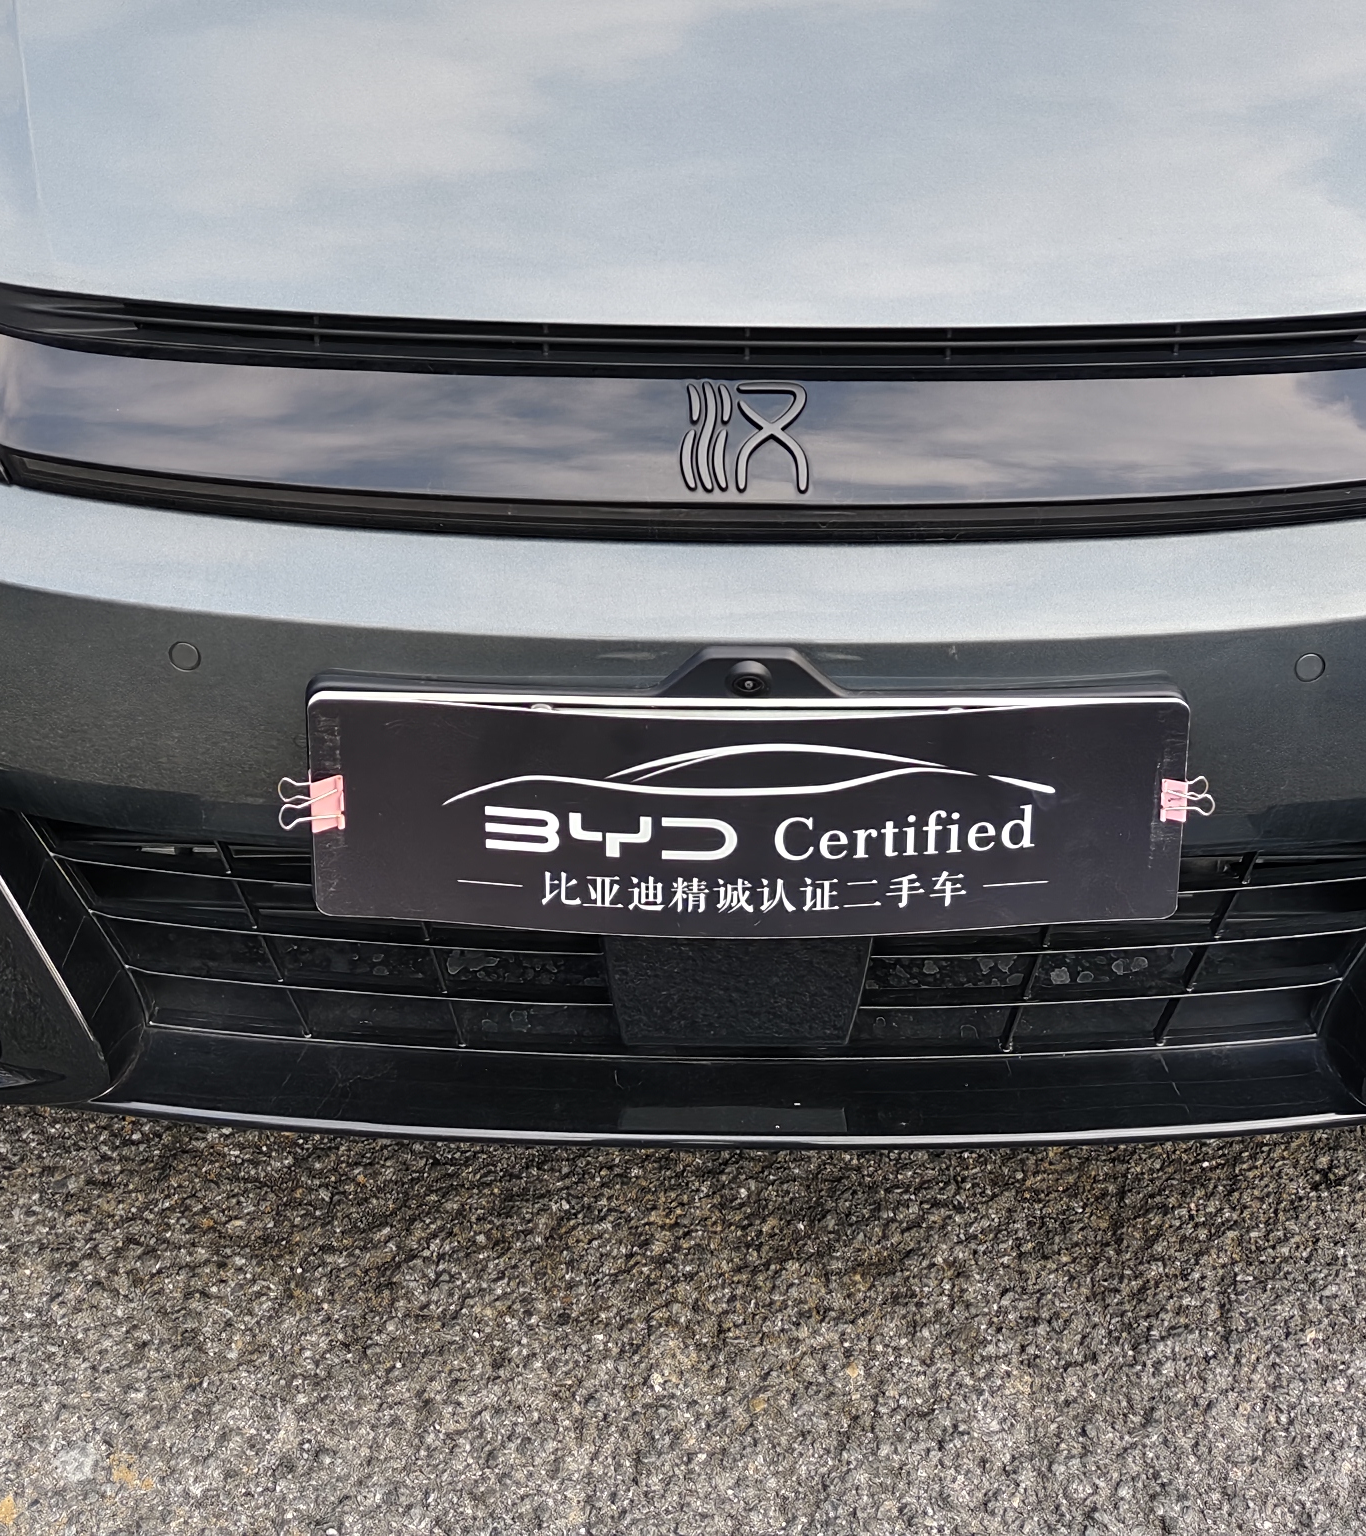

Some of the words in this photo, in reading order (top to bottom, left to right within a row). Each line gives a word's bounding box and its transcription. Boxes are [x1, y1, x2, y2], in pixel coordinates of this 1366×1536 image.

[485, 805, 737, 861] BYD
[774, 804, 1035, 862] Certified
[541, 870, 967, 914] 比亚迪精诚认证二手车
